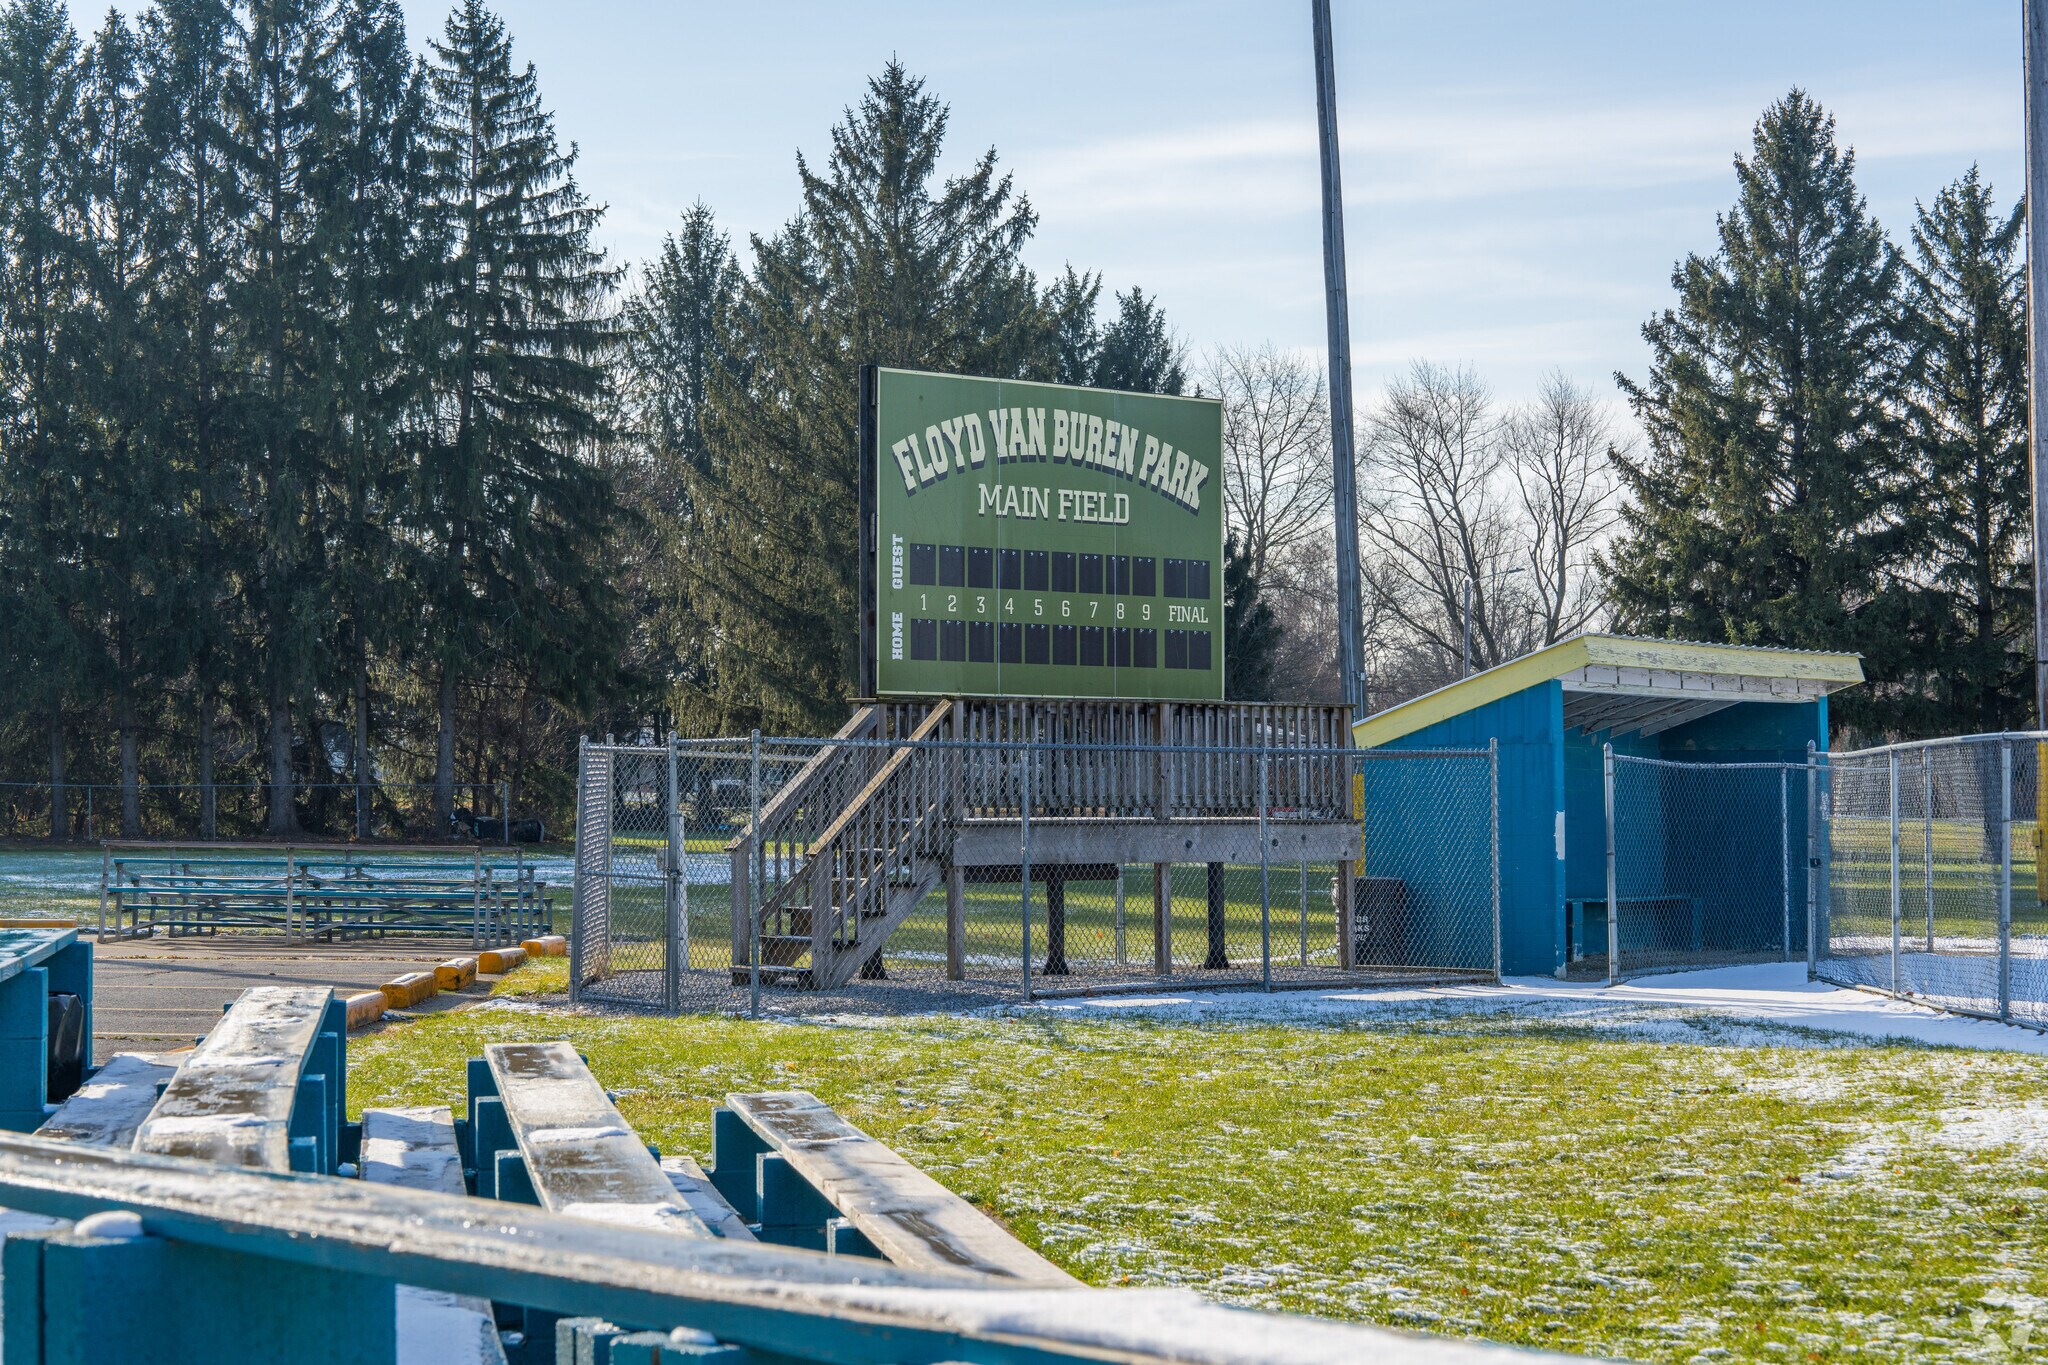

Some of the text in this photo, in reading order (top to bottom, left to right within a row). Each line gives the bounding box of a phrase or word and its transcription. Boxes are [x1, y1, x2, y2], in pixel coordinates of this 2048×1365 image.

[891, 407, 1209, 510] FLOYD VAN BUREN PARK
[979, 481, 1129, 523] MAIN FIELD
[892, 534, 903, 589] GUEST
[920, 593, 1208, 623] 1 2 3 4 5 6 7 8 9 FINAL
[892, 612, 903, 660] HOME
